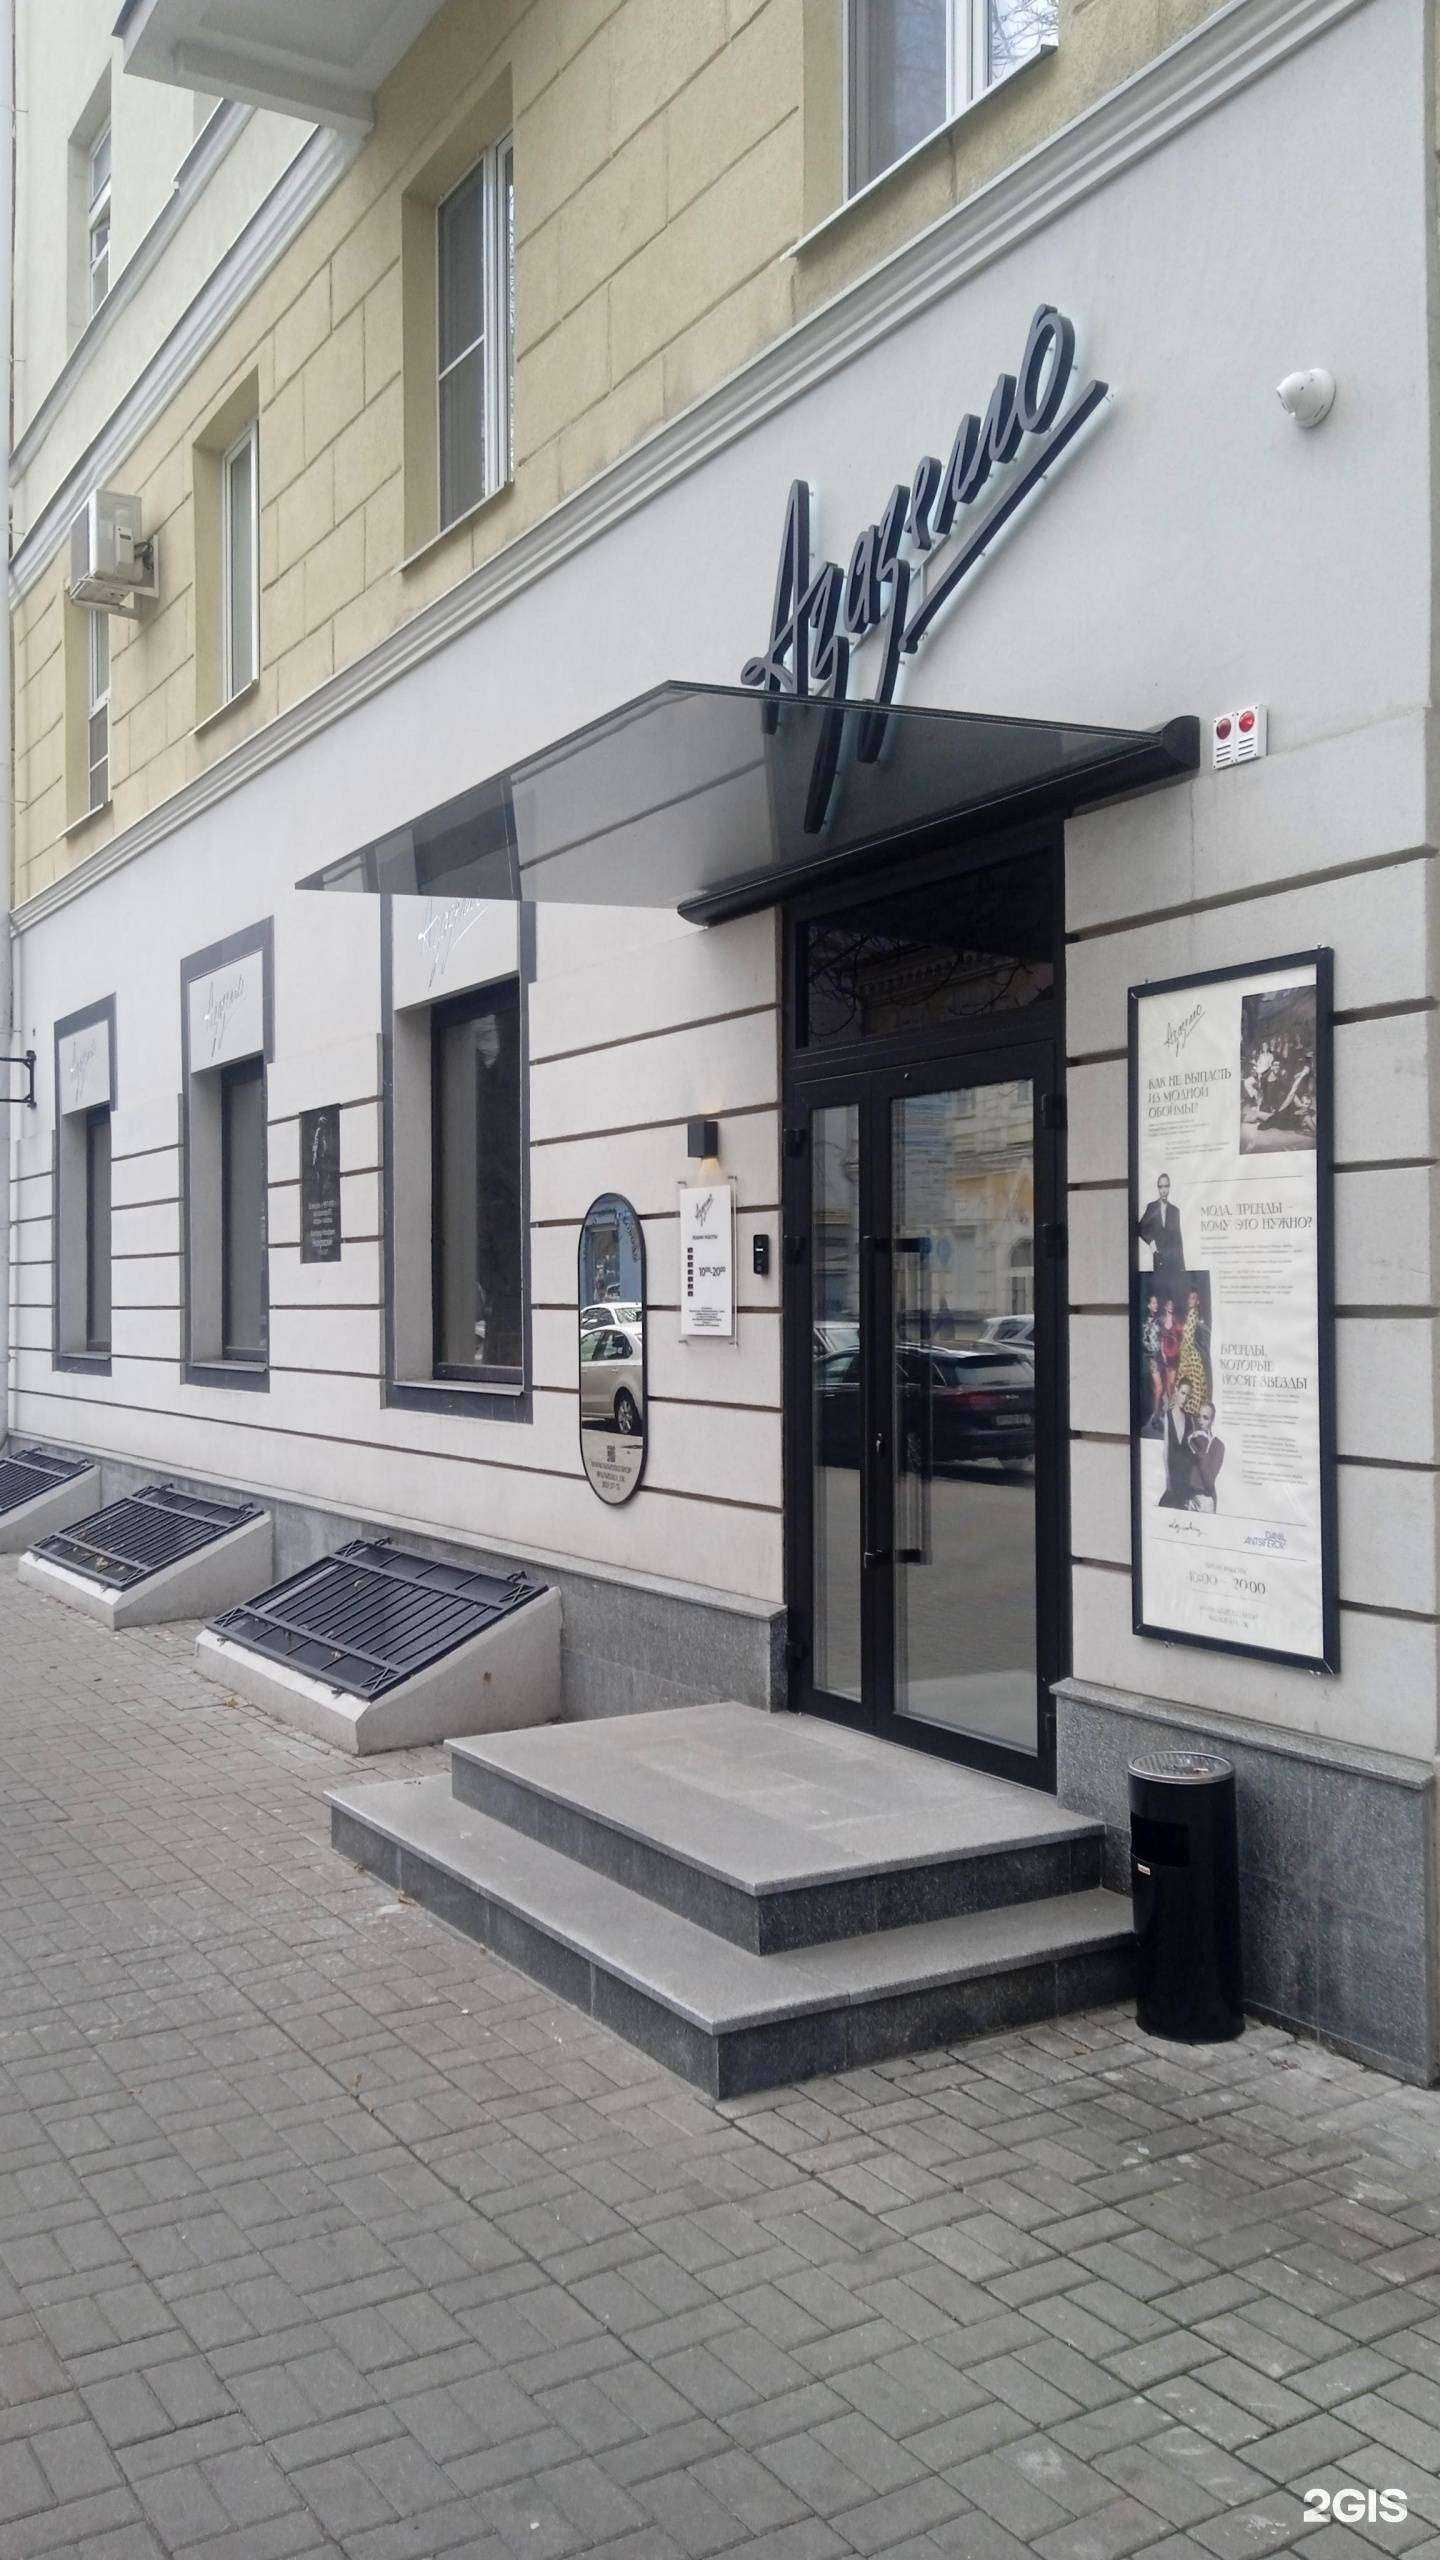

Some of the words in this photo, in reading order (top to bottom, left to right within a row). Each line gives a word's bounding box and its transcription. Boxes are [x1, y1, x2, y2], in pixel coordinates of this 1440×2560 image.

[1168, 1074, 1181, 1087] НЕ
[1184, 1067, 1232, 1085] ВЫПАСТЬ
[1163, 1085, 1209, 1102] МОДНОЙ
[1238, 1202, 1283, 1216] ТРЕНДЫ
[1200, 1219, 1230, 1232] КОМУ
[1235, 1218, 1259, 1231] ЭТО
[1262, 1216, 1313, 1231] НУЖНО?
[1220, 1358, 1273, 1373] КОТОРЫЕ
[1221, 1373, 1257, 1388] НОСЯТ
[1260, 1376, 1308, 1391] ЗВЕЗДЫ
